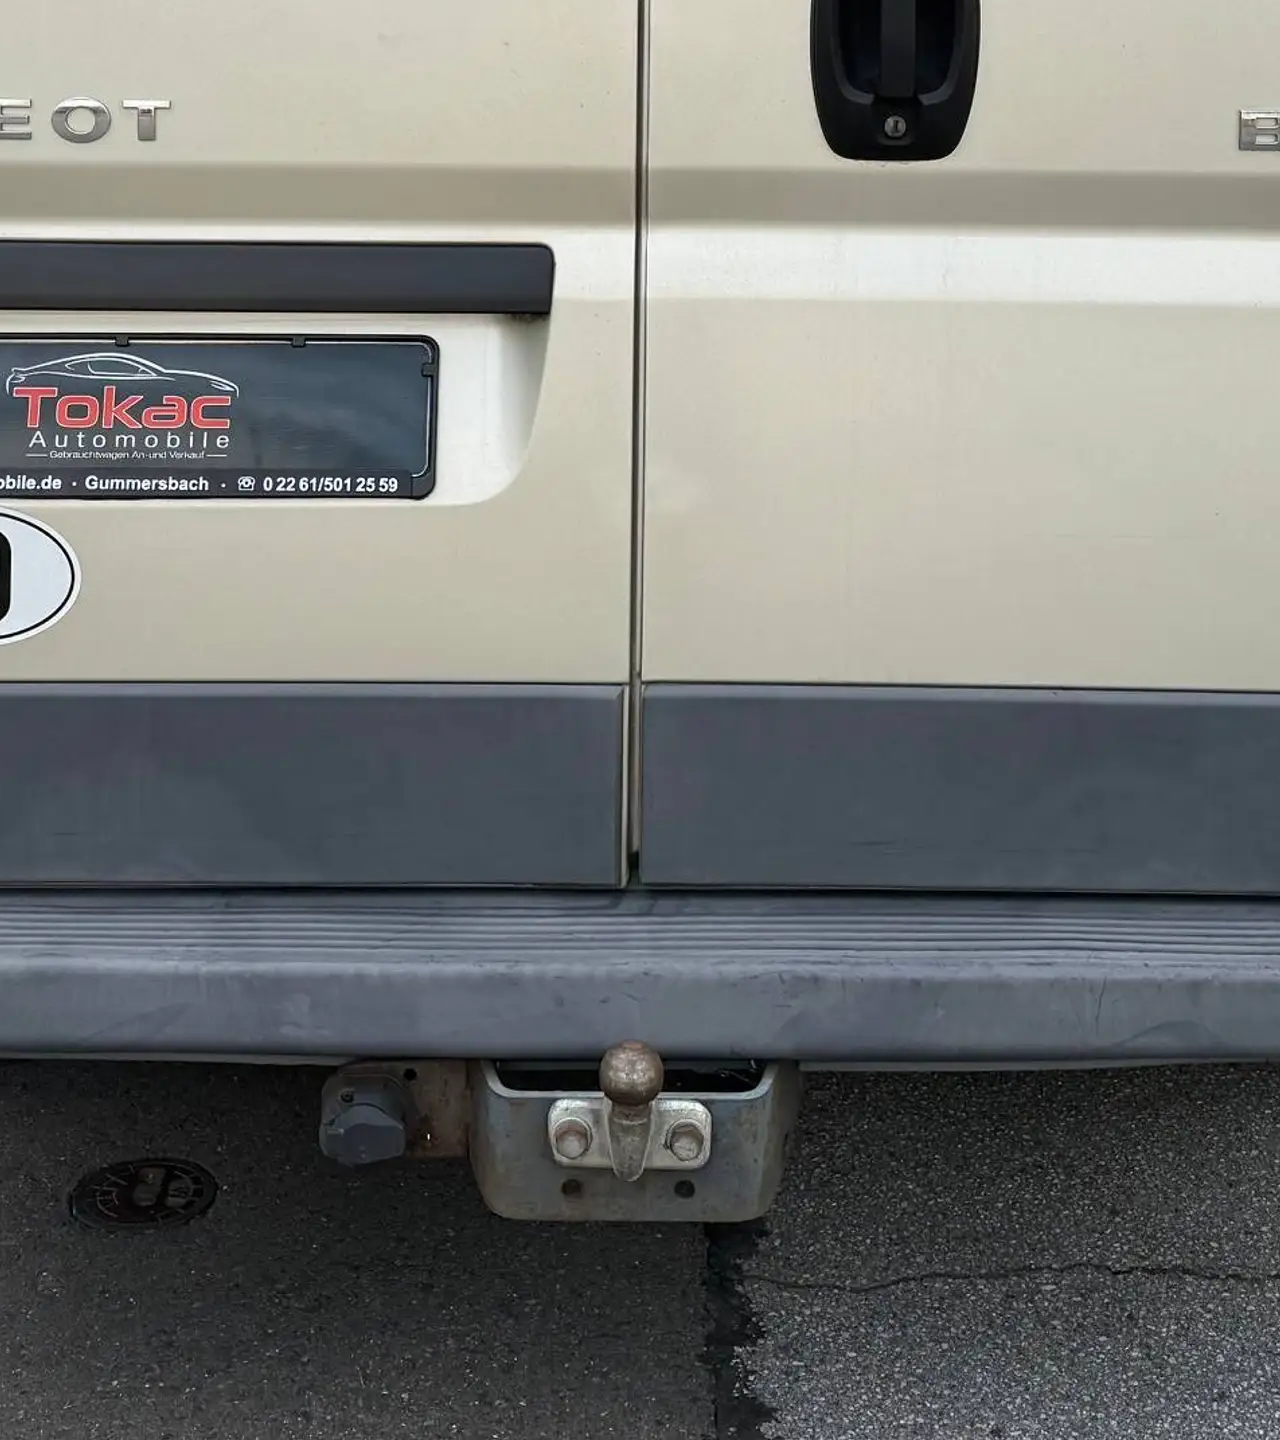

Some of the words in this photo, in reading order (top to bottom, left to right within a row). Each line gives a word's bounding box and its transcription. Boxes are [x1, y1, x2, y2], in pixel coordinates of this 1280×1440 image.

[12, 386, 232, 429] Tokac
[28, 430, 230, 448] Automobile
[84, 475, 209, 491] Gummersbach
